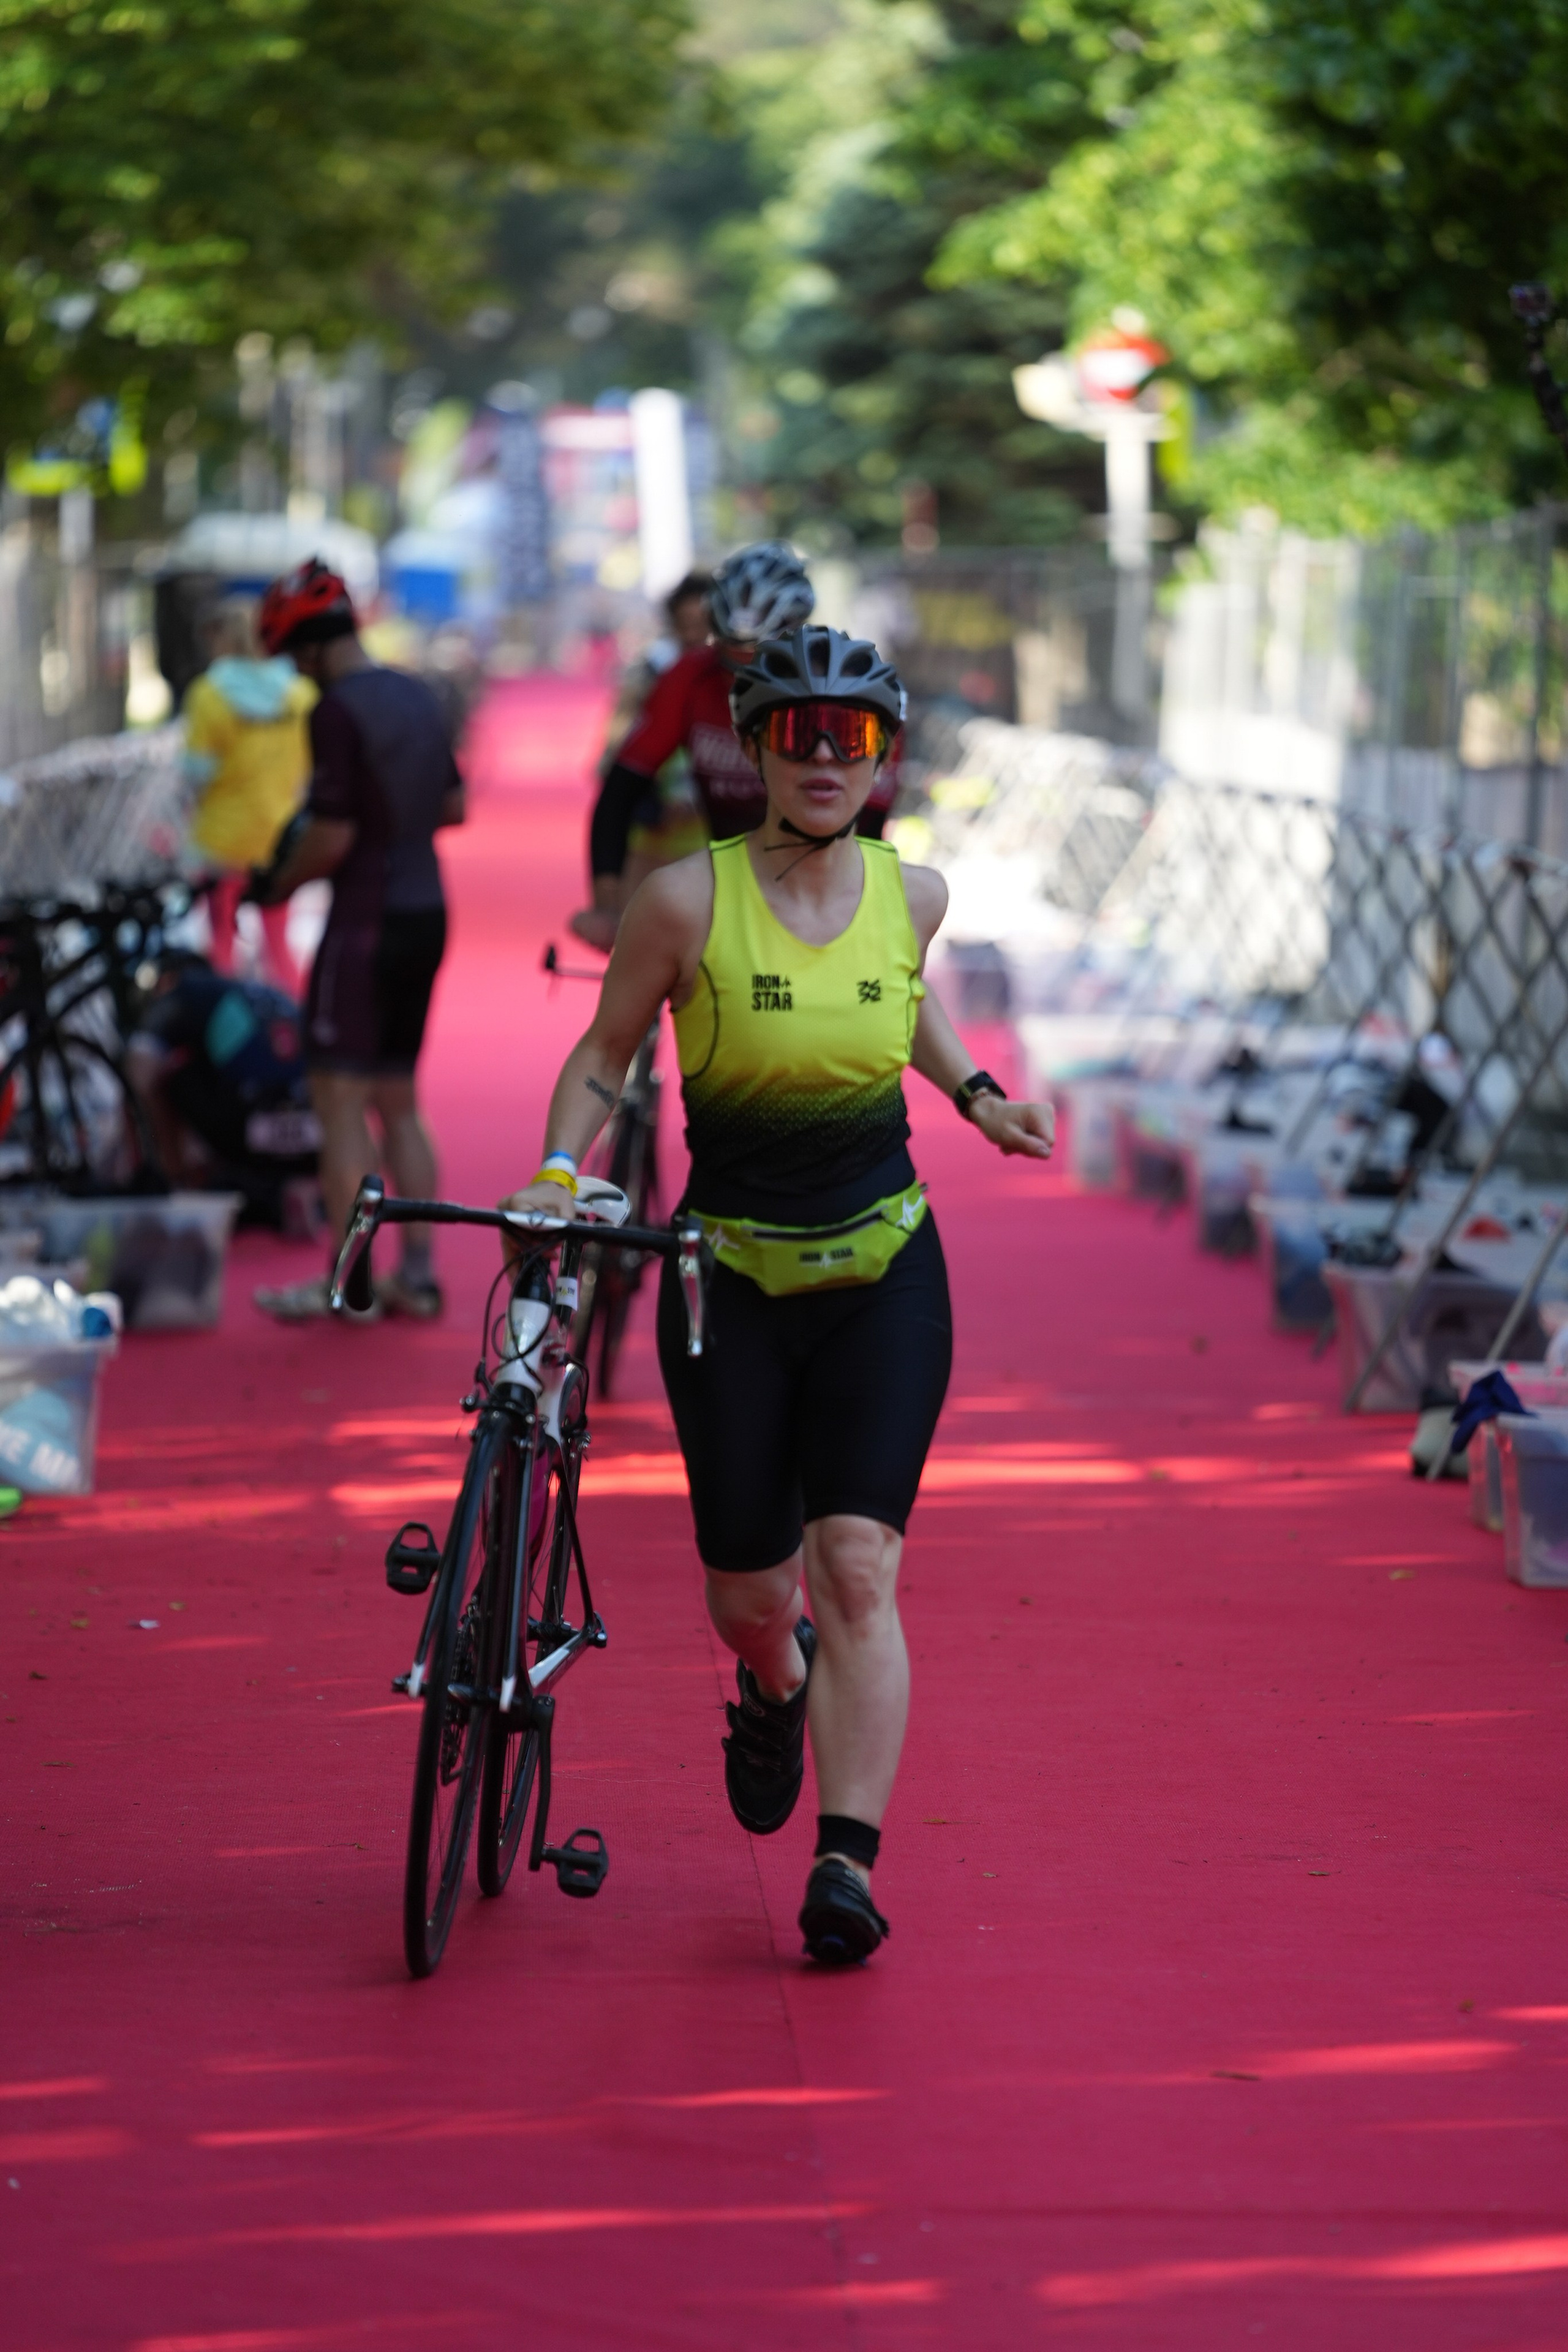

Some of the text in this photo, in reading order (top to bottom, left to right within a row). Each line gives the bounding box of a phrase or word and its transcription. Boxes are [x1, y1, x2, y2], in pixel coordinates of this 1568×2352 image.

[752, 974, 780, 989] IRON
[752, 992, 792, 1011] STAR
[799, 1246, 853, 1262] IRON STAR
